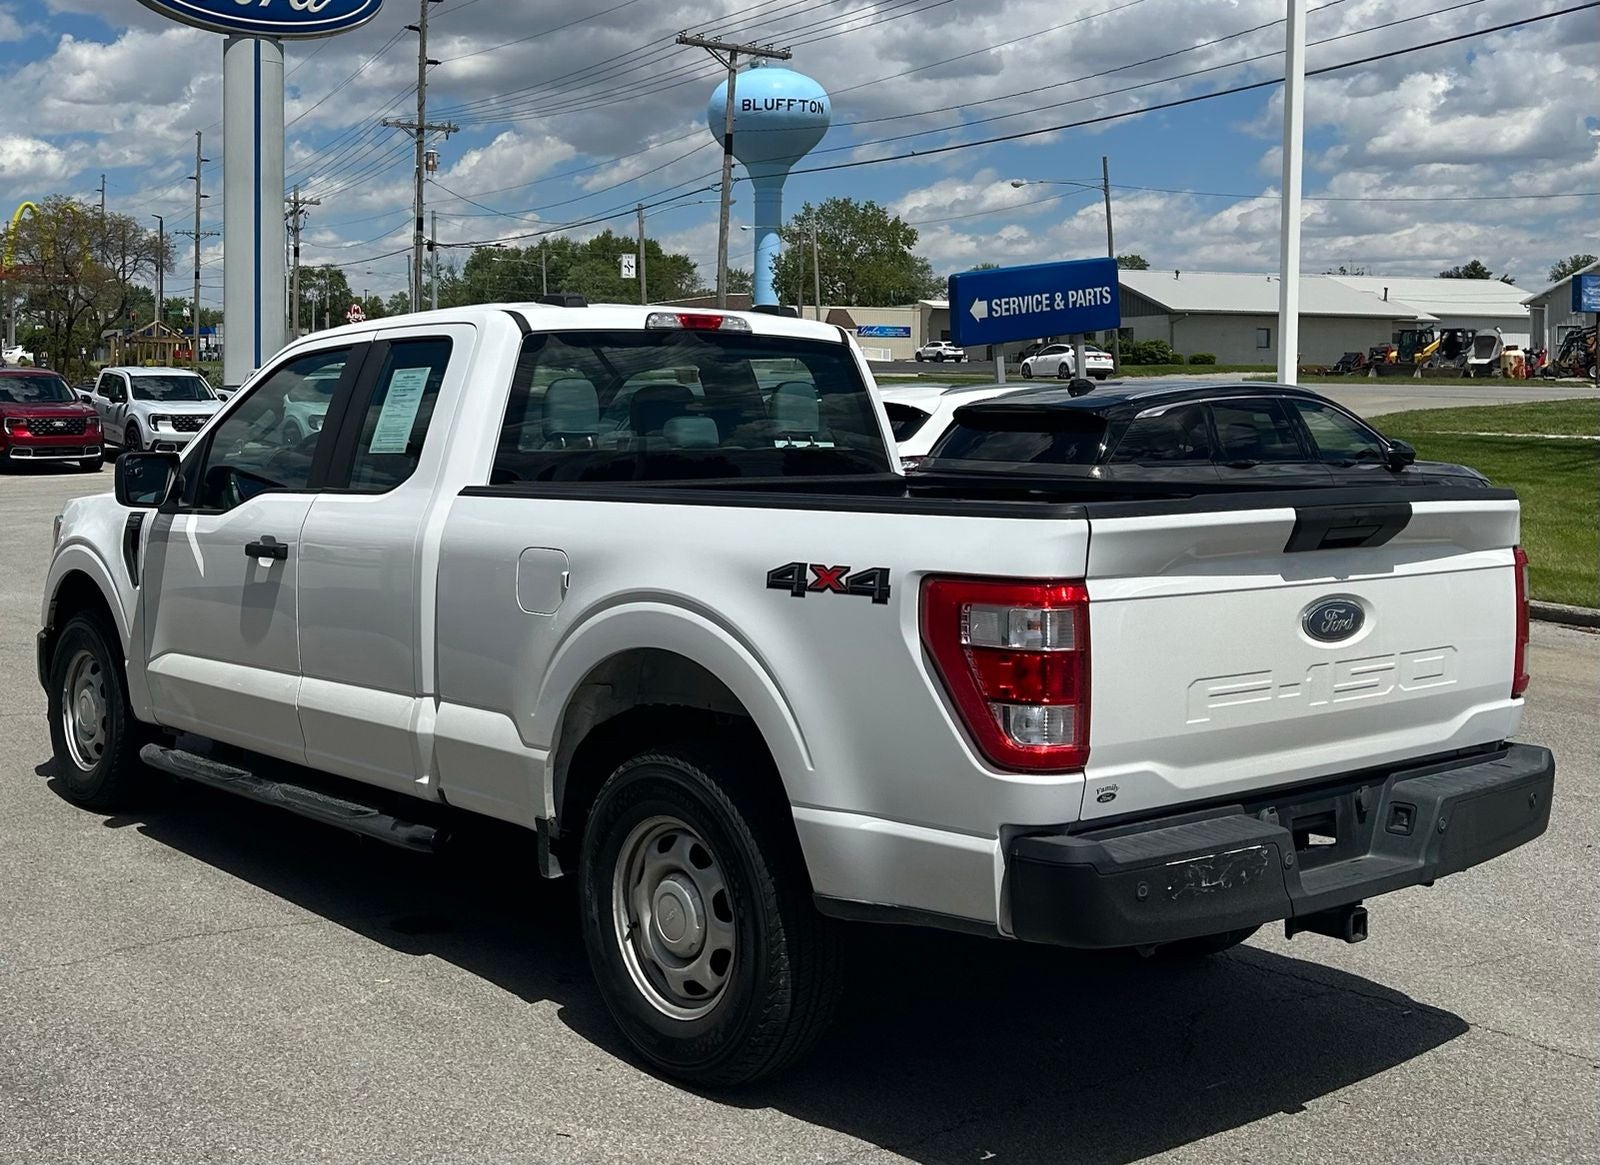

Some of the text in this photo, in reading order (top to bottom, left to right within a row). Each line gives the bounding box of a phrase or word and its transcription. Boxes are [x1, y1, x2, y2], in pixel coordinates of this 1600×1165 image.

[742, 98, 825, 115] BLUFFTON
[992, 286, 1112, 318] SERVICE & PARTS
[1321, 608, 1355, 633] Ford
[1186, 645, 1458, 725] F-150
